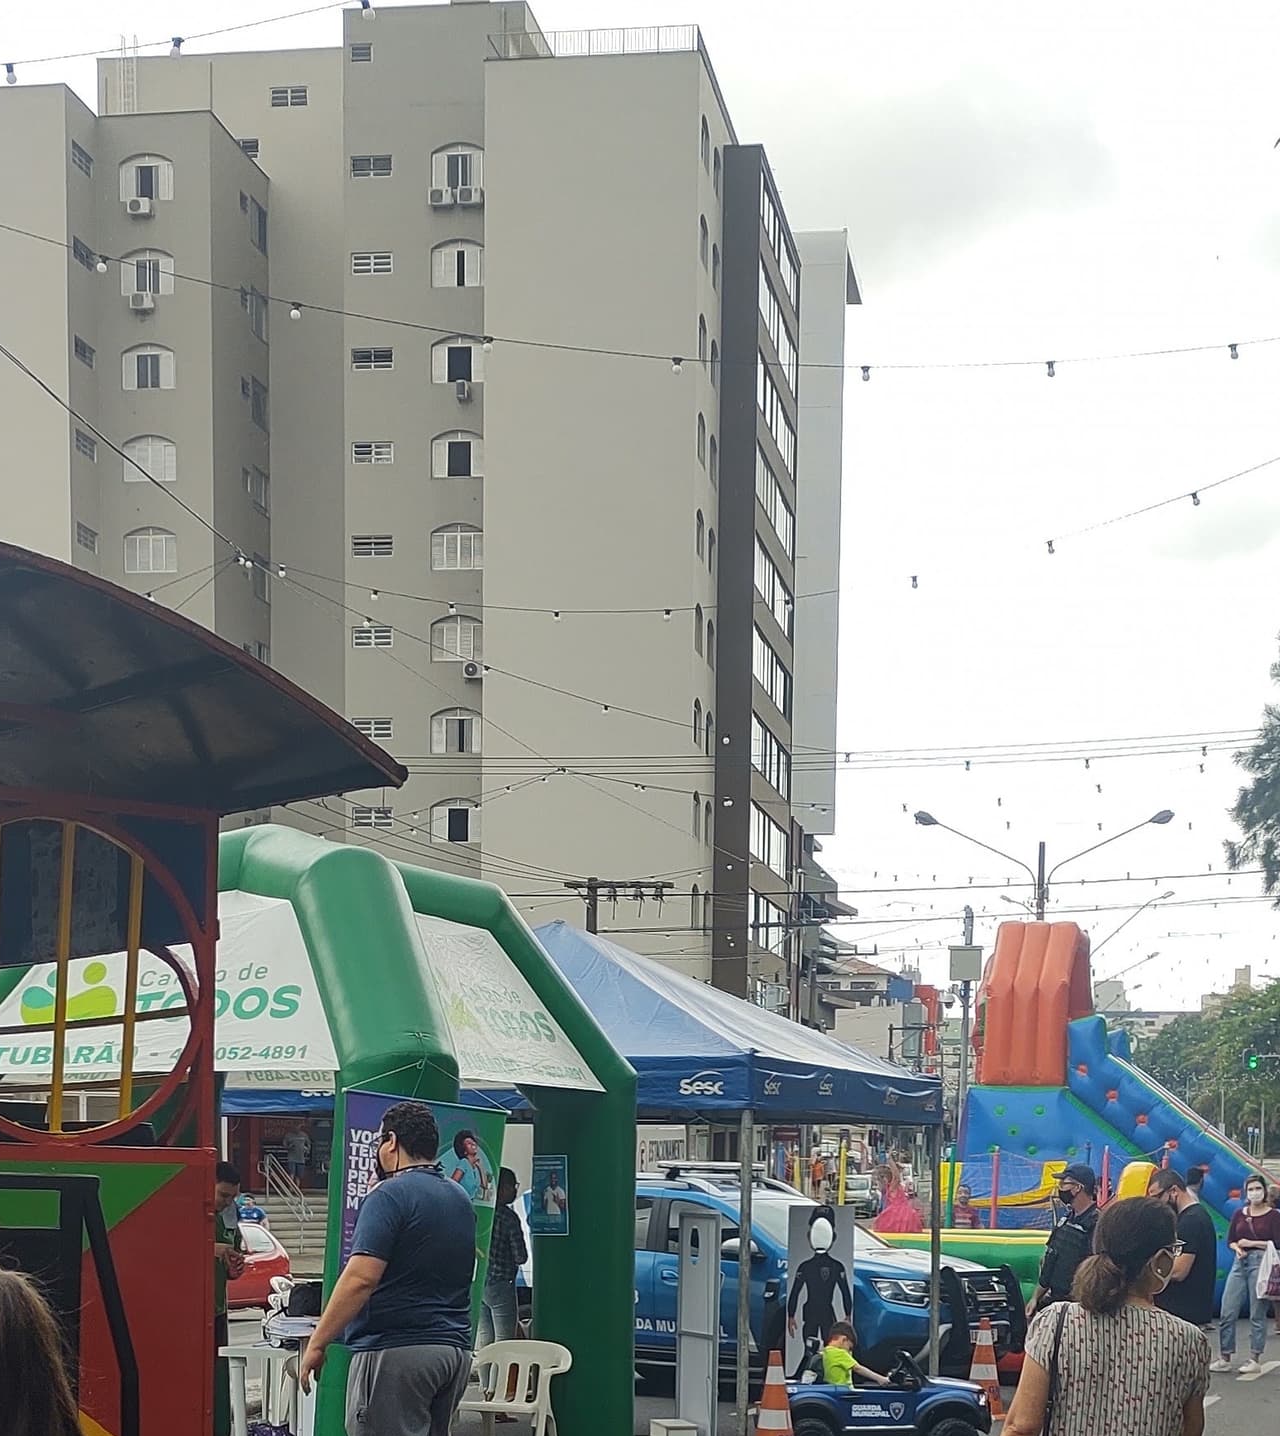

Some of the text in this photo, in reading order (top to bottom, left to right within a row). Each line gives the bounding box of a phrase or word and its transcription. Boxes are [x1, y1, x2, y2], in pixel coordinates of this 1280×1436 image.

[238, 962, 269, 981] de
[679, 1073, 724, 1096] Sesc
[350, 1128, 382, 1143] VOC
[349, 1156, 378, 1171] TUD
[347, 1183, 370, 1198] SE
